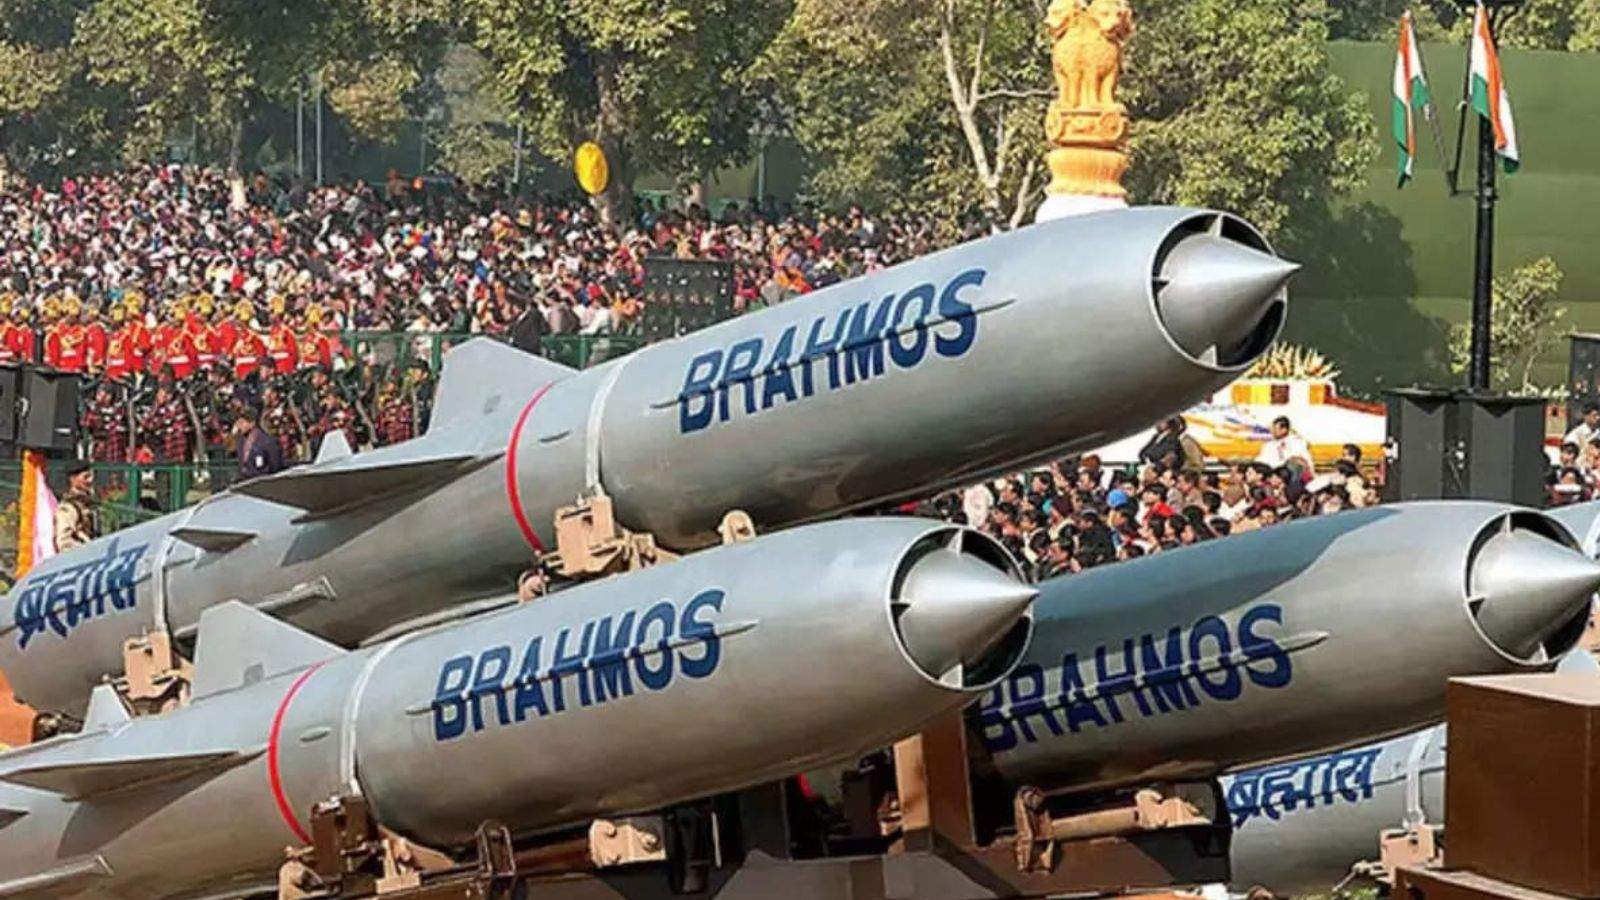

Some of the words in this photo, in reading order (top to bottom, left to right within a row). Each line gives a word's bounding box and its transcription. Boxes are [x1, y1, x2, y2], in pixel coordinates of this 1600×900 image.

[680, 268, 987, 434] BRAHMOS
[432, 588, 726, 741] BRAHMOS
[980, 603, 1293, 753] BRAHMOS
